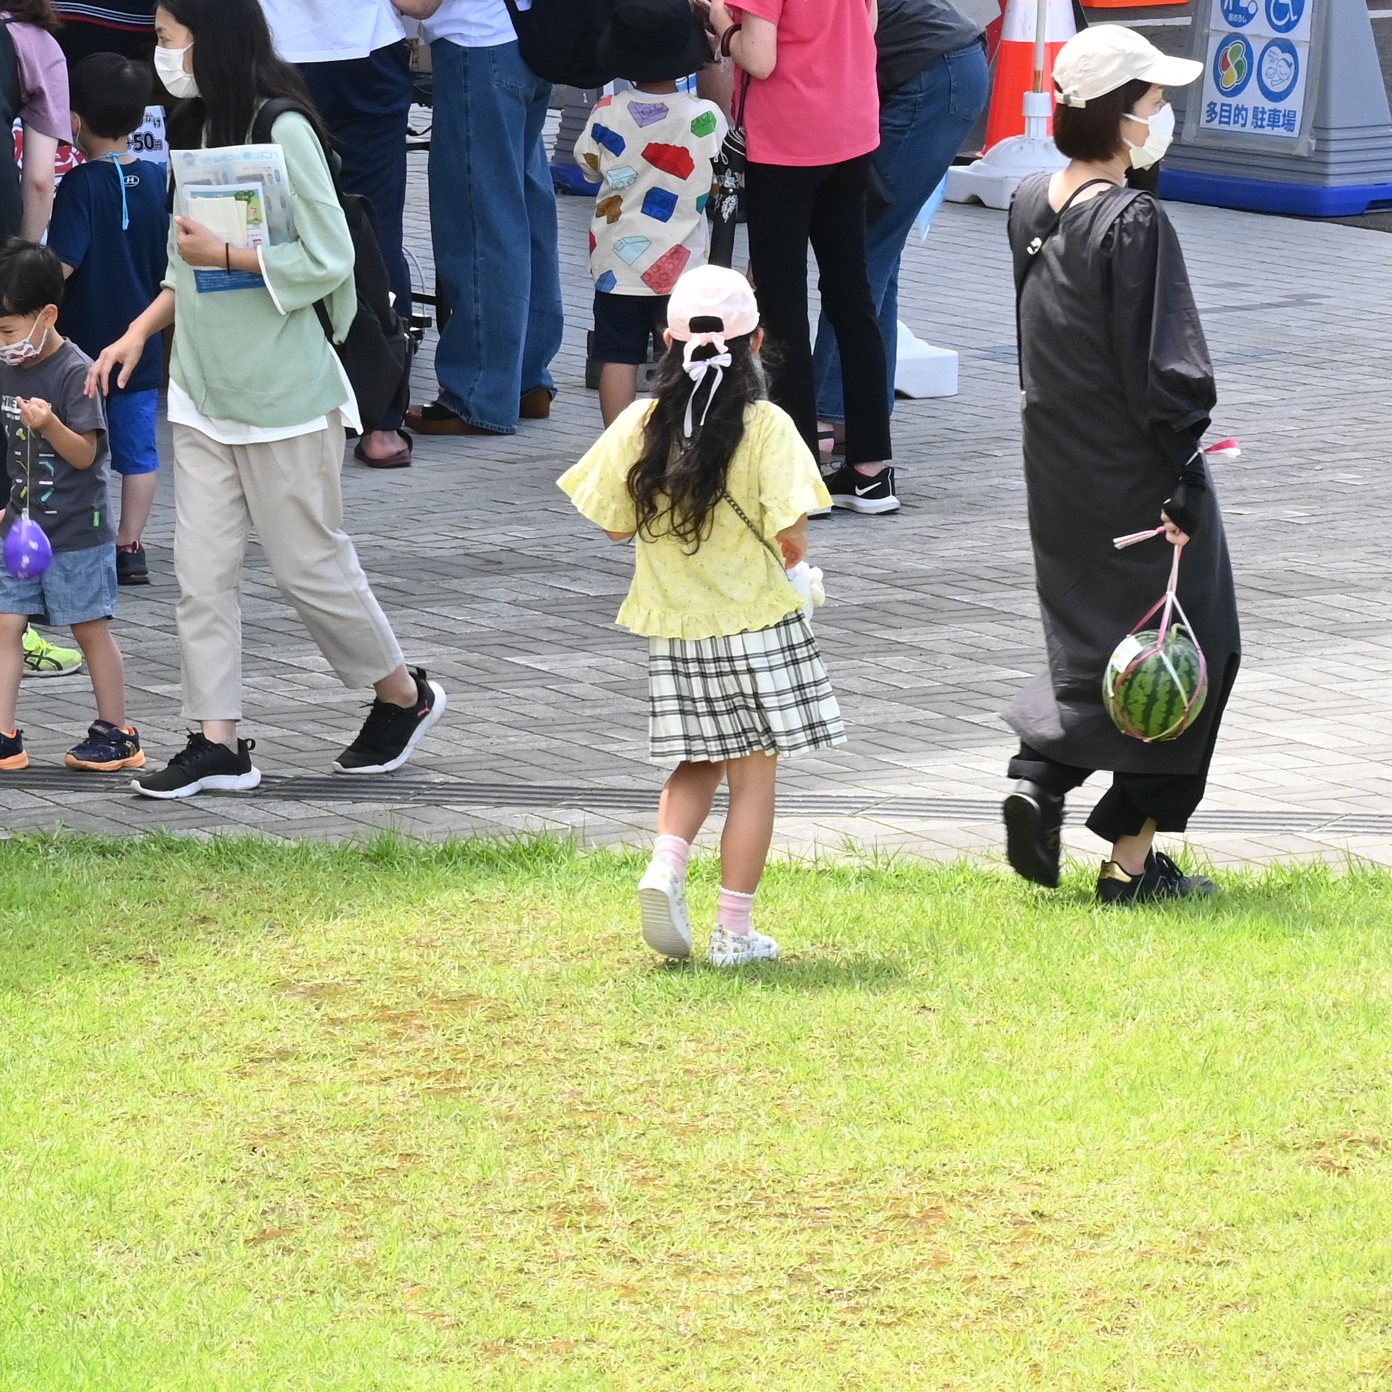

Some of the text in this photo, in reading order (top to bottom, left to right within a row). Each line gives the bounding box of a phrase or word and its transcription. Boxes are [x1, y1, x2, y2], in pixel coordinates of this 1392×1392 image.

[1205, 101, 1298, 133] 多目的 駐車場
